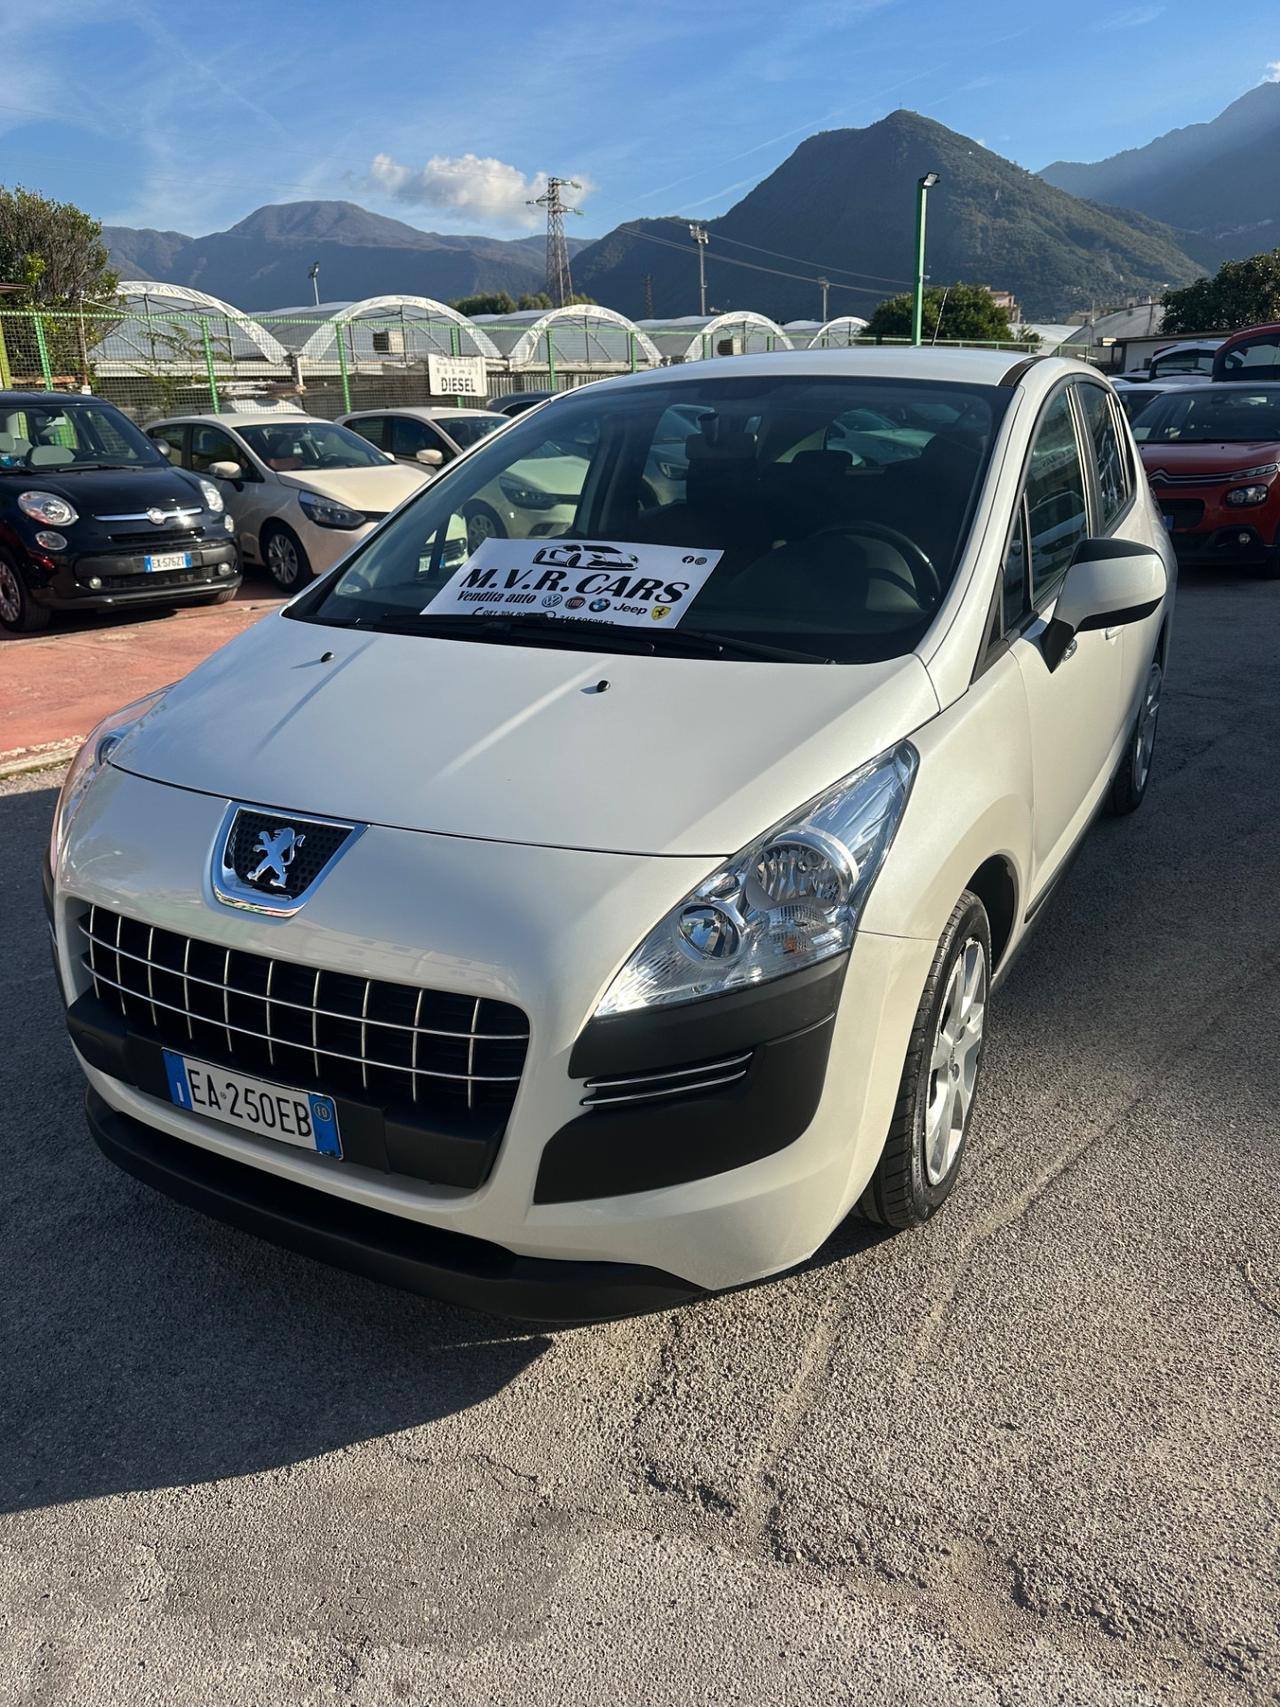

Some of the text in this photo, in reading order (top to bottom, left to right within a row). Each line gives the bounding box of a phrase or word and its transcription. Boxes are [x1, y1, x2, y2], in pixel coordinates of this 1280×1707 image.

[441, 377, 476, 393] DIESEL
[457, 590, 537, 604] Vendita auto
[613, 603, 648, 616] Jeep
